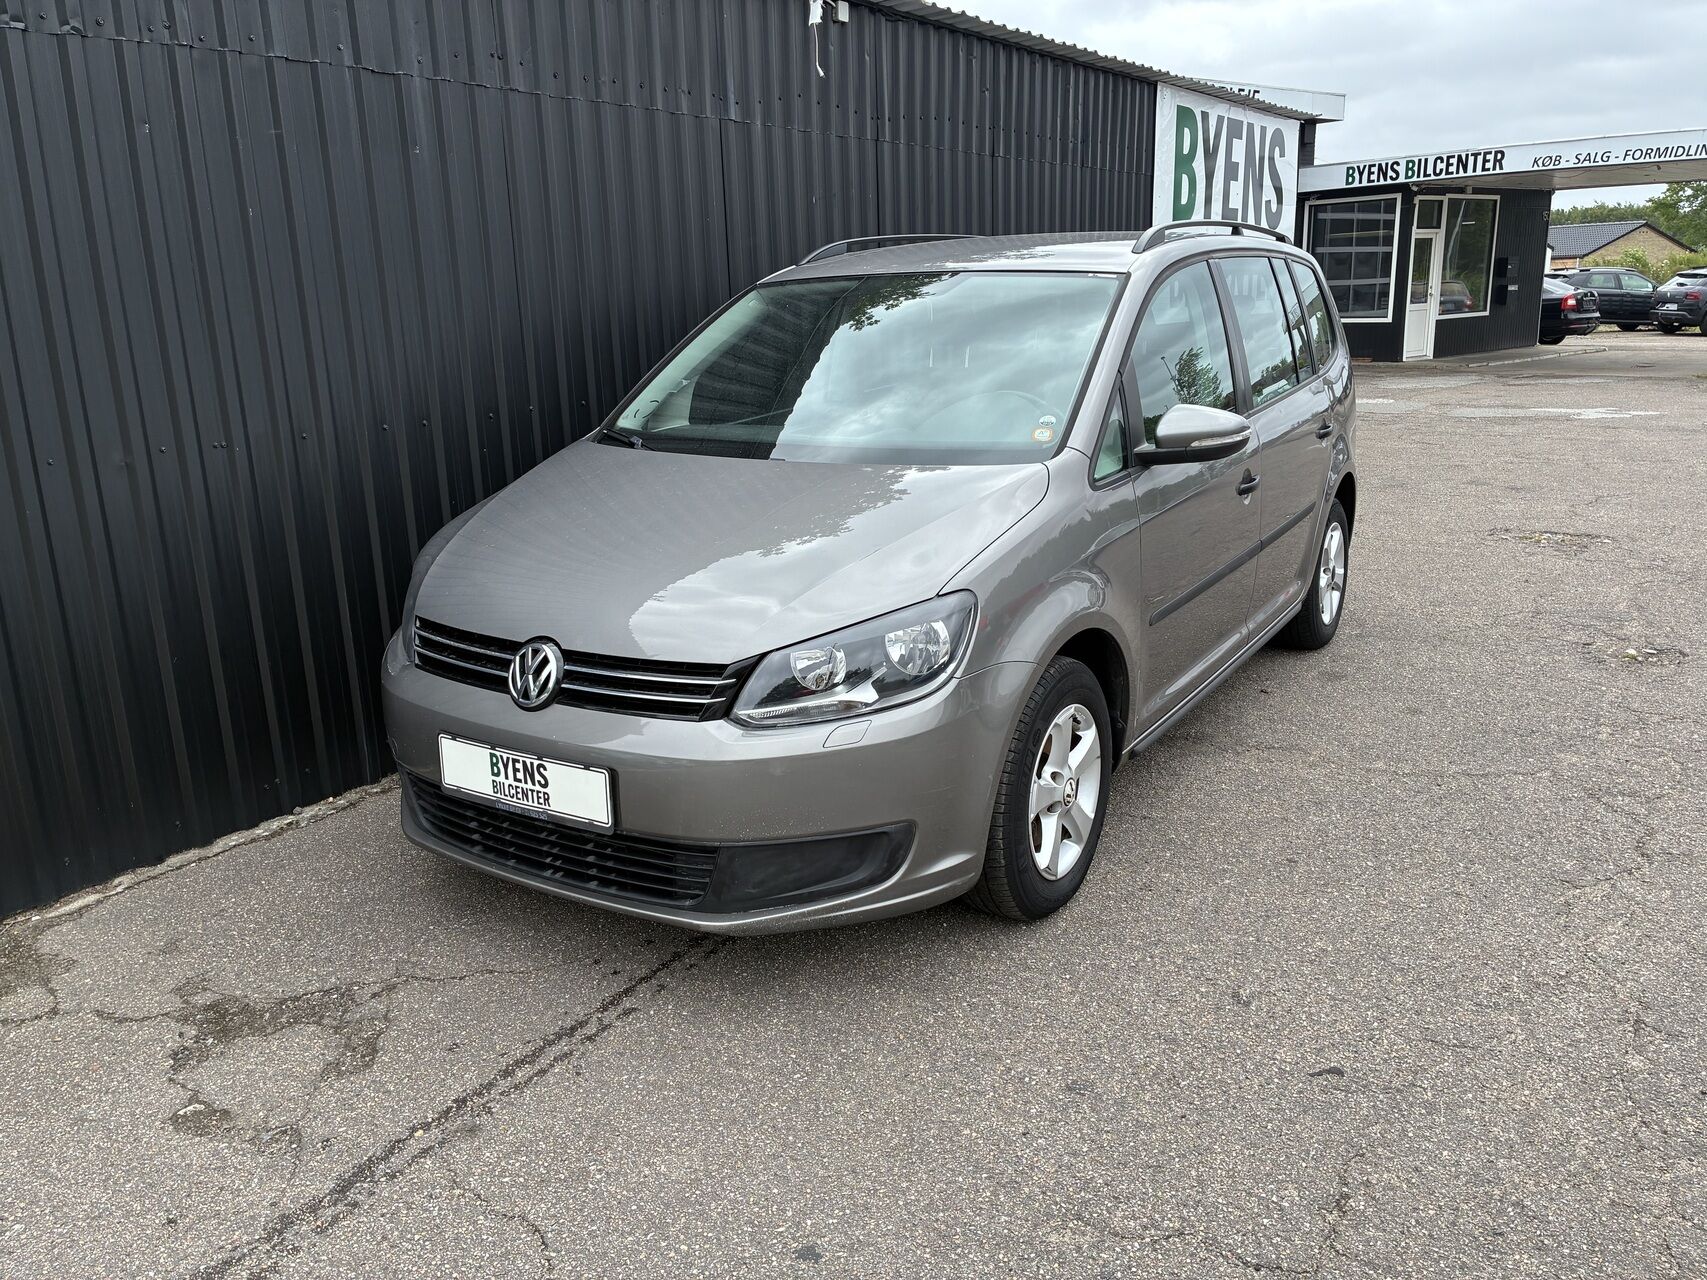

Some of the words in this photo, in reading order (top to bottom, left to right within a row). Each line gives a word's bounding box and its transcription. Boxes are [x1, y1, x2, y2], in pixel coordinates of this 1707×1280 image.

[1172, 104, 1286, 230] BYENS
[1345, 160, 1401, 186] BYENS
[1404, 149, 1506, 180] BILCENTER
[1531, 154, 1562, 169] KØB
[1573, 150, 1612, 165] SALG
[489, 751, 550, 789] BYENS
[491, 779, 551, 808] BILCENTER
